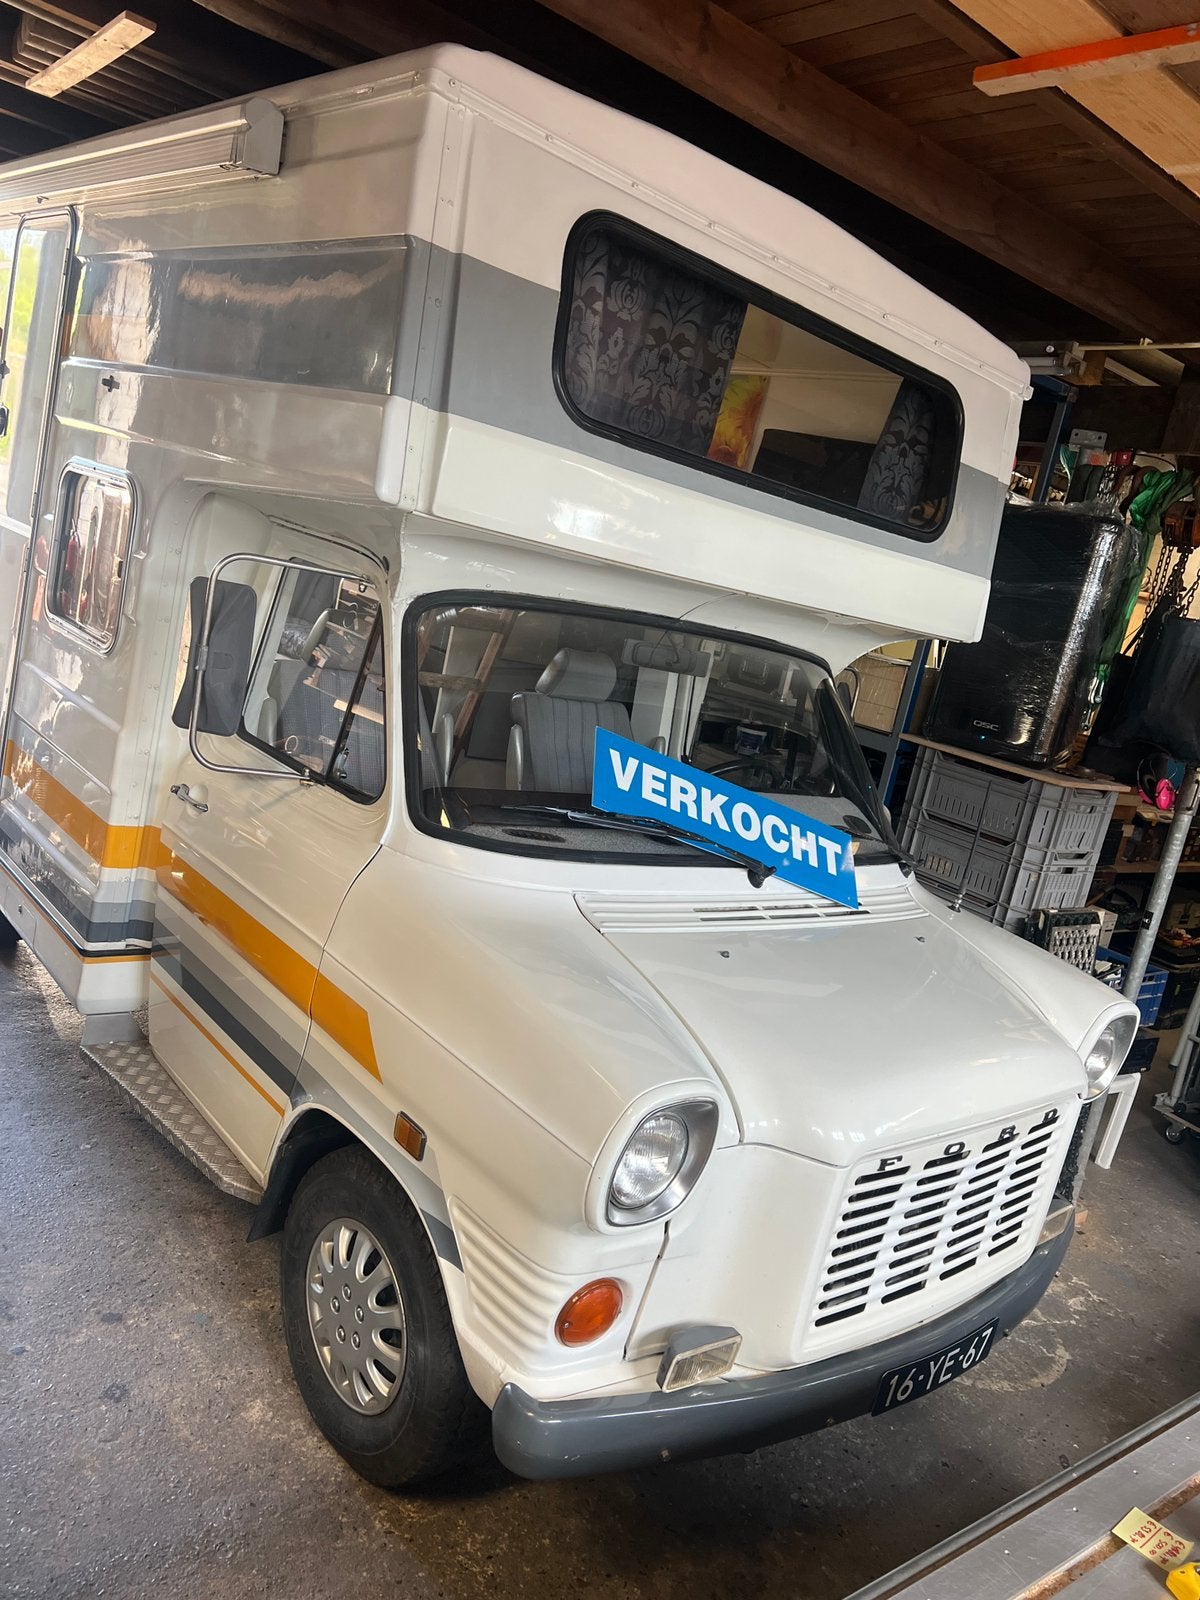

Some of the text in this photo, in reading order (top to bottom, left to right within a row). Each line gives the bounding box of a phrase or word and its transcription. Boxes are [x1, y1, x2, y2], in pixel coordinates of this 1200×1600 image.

[973, 719, 999, 731] QSC
[609, 748, 842, 877] VERKOCHT
[877, 1108, 1058, 1172] FORD
